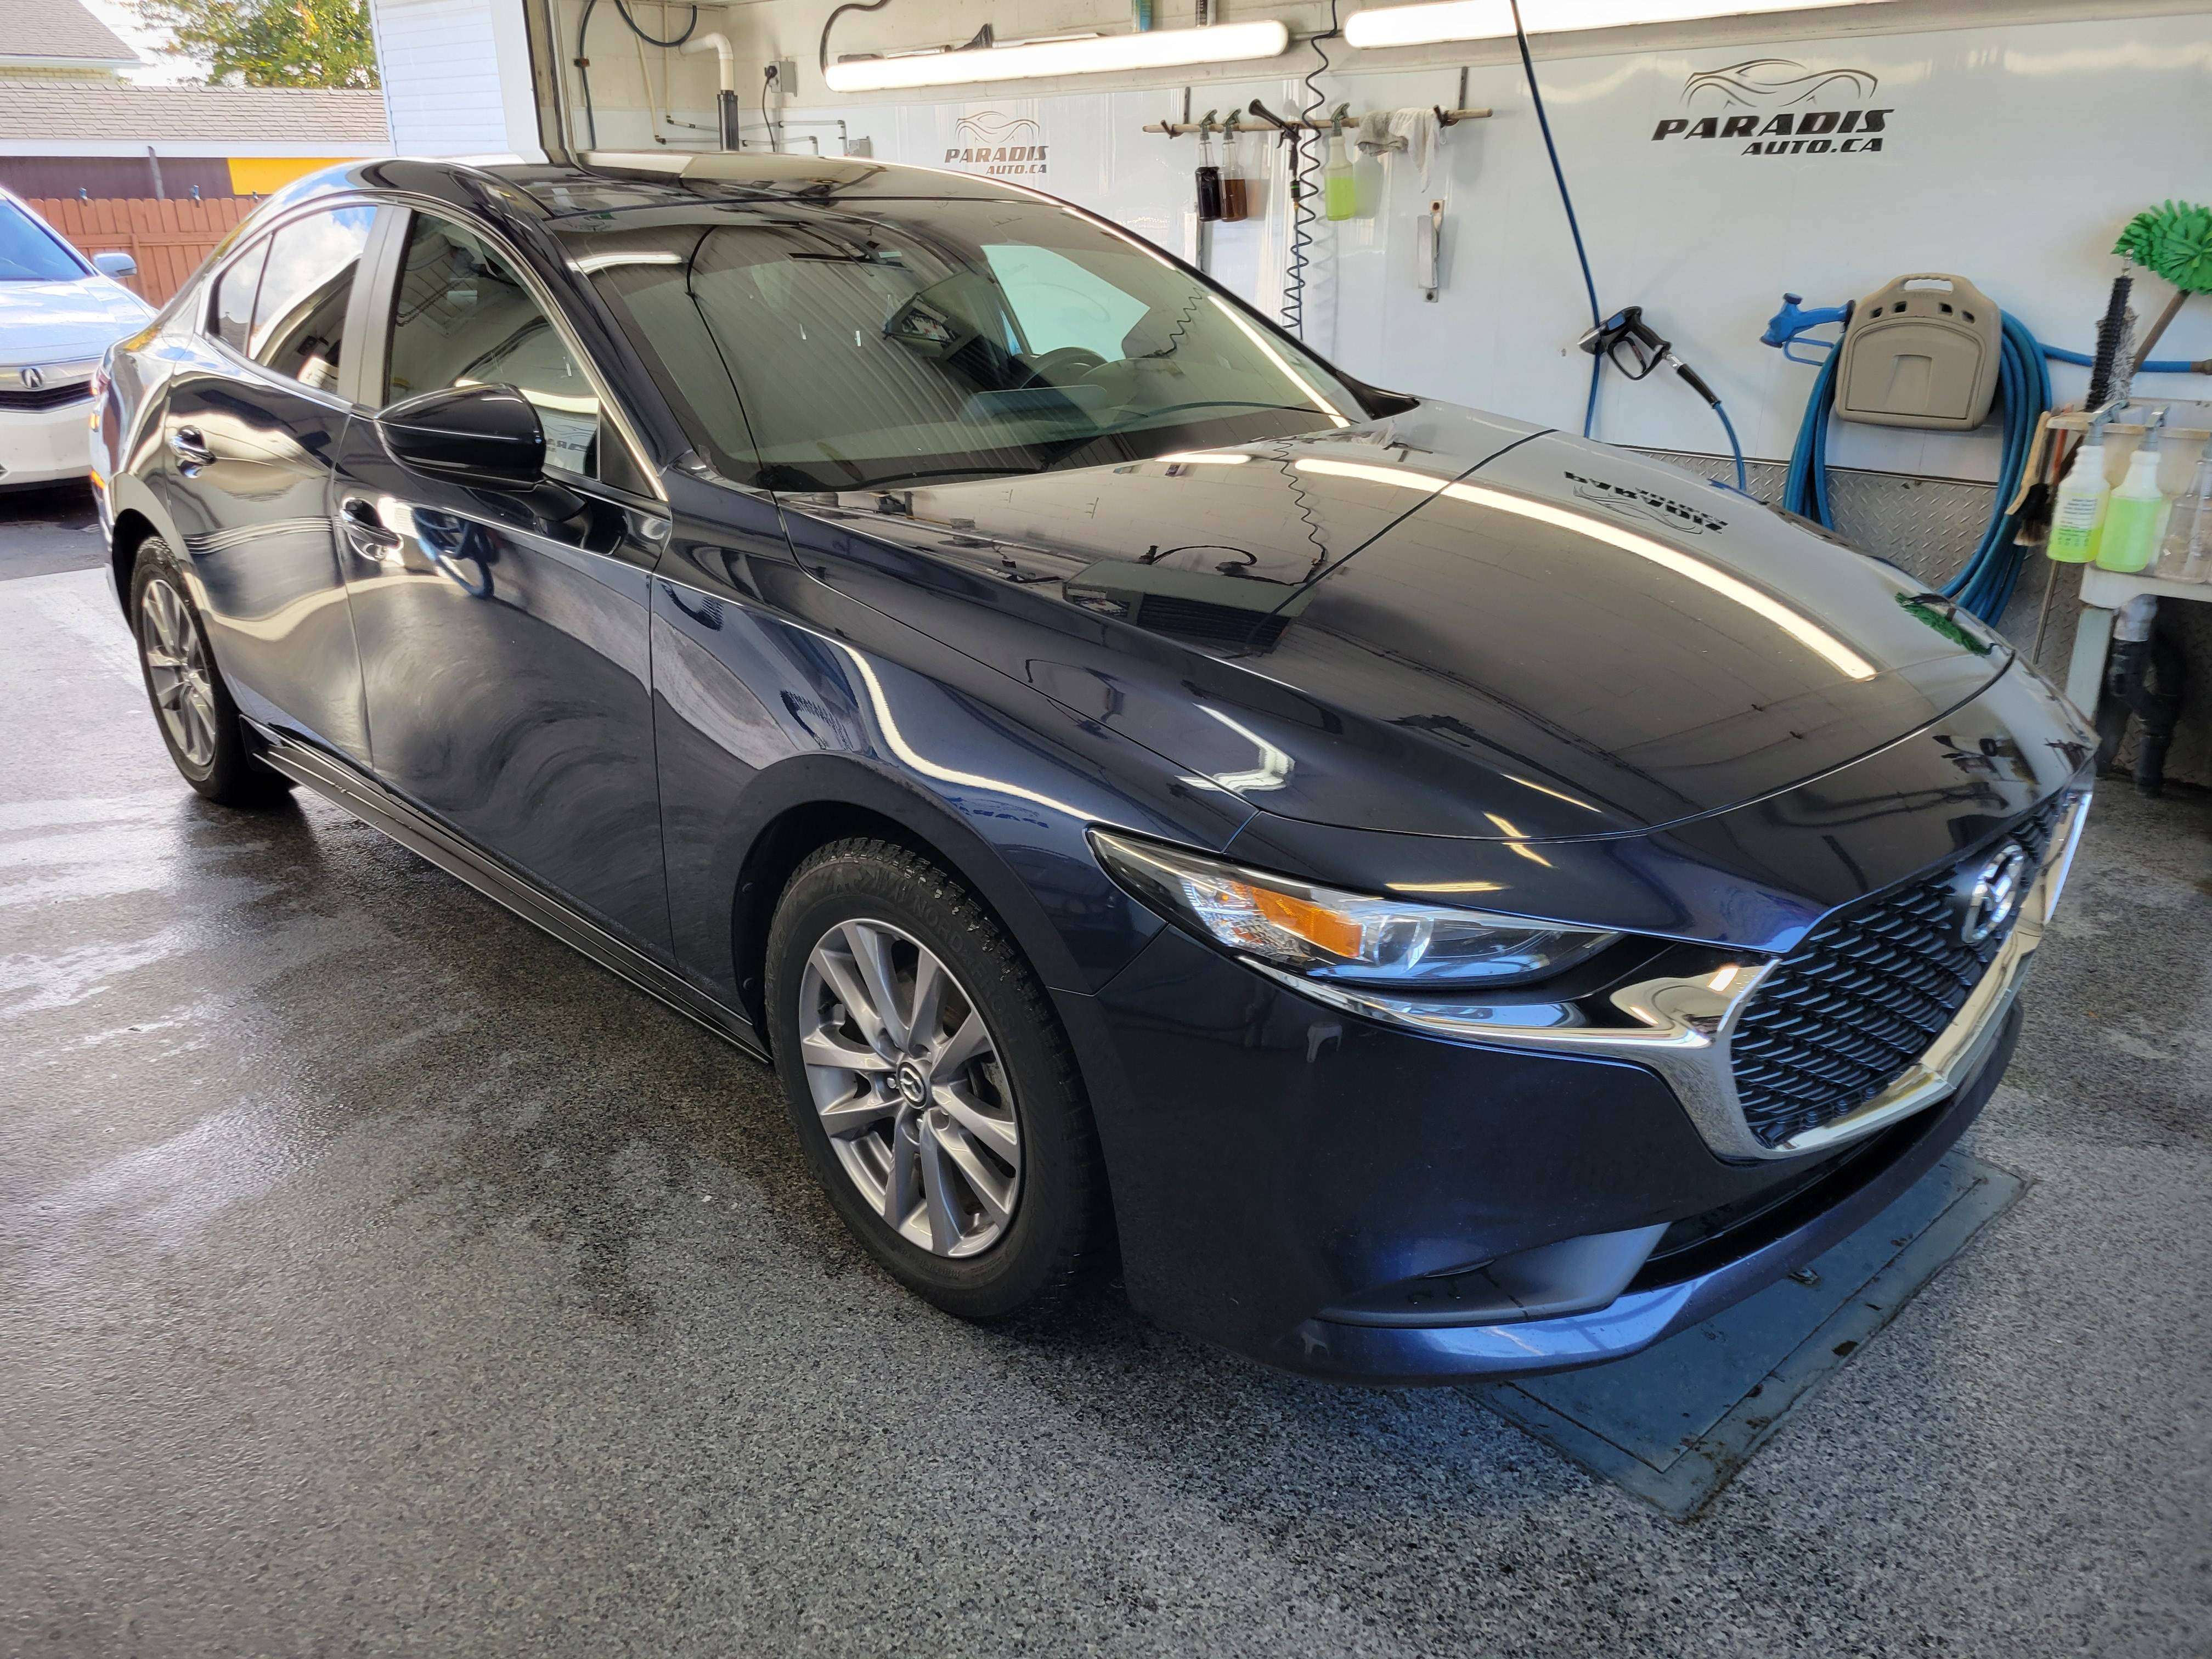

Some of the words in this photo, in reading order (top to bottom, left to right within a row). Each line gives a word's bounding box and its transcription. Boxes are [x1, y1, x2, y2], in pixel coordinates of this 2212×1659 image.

[1651, 109, 1894, 140] PARADIS
[944, 145, 1049, 163] PARADIS
[1741, 137, 1883, 156] AUTO.CA
[986, 164, 1047, 174] AUTO.CA
